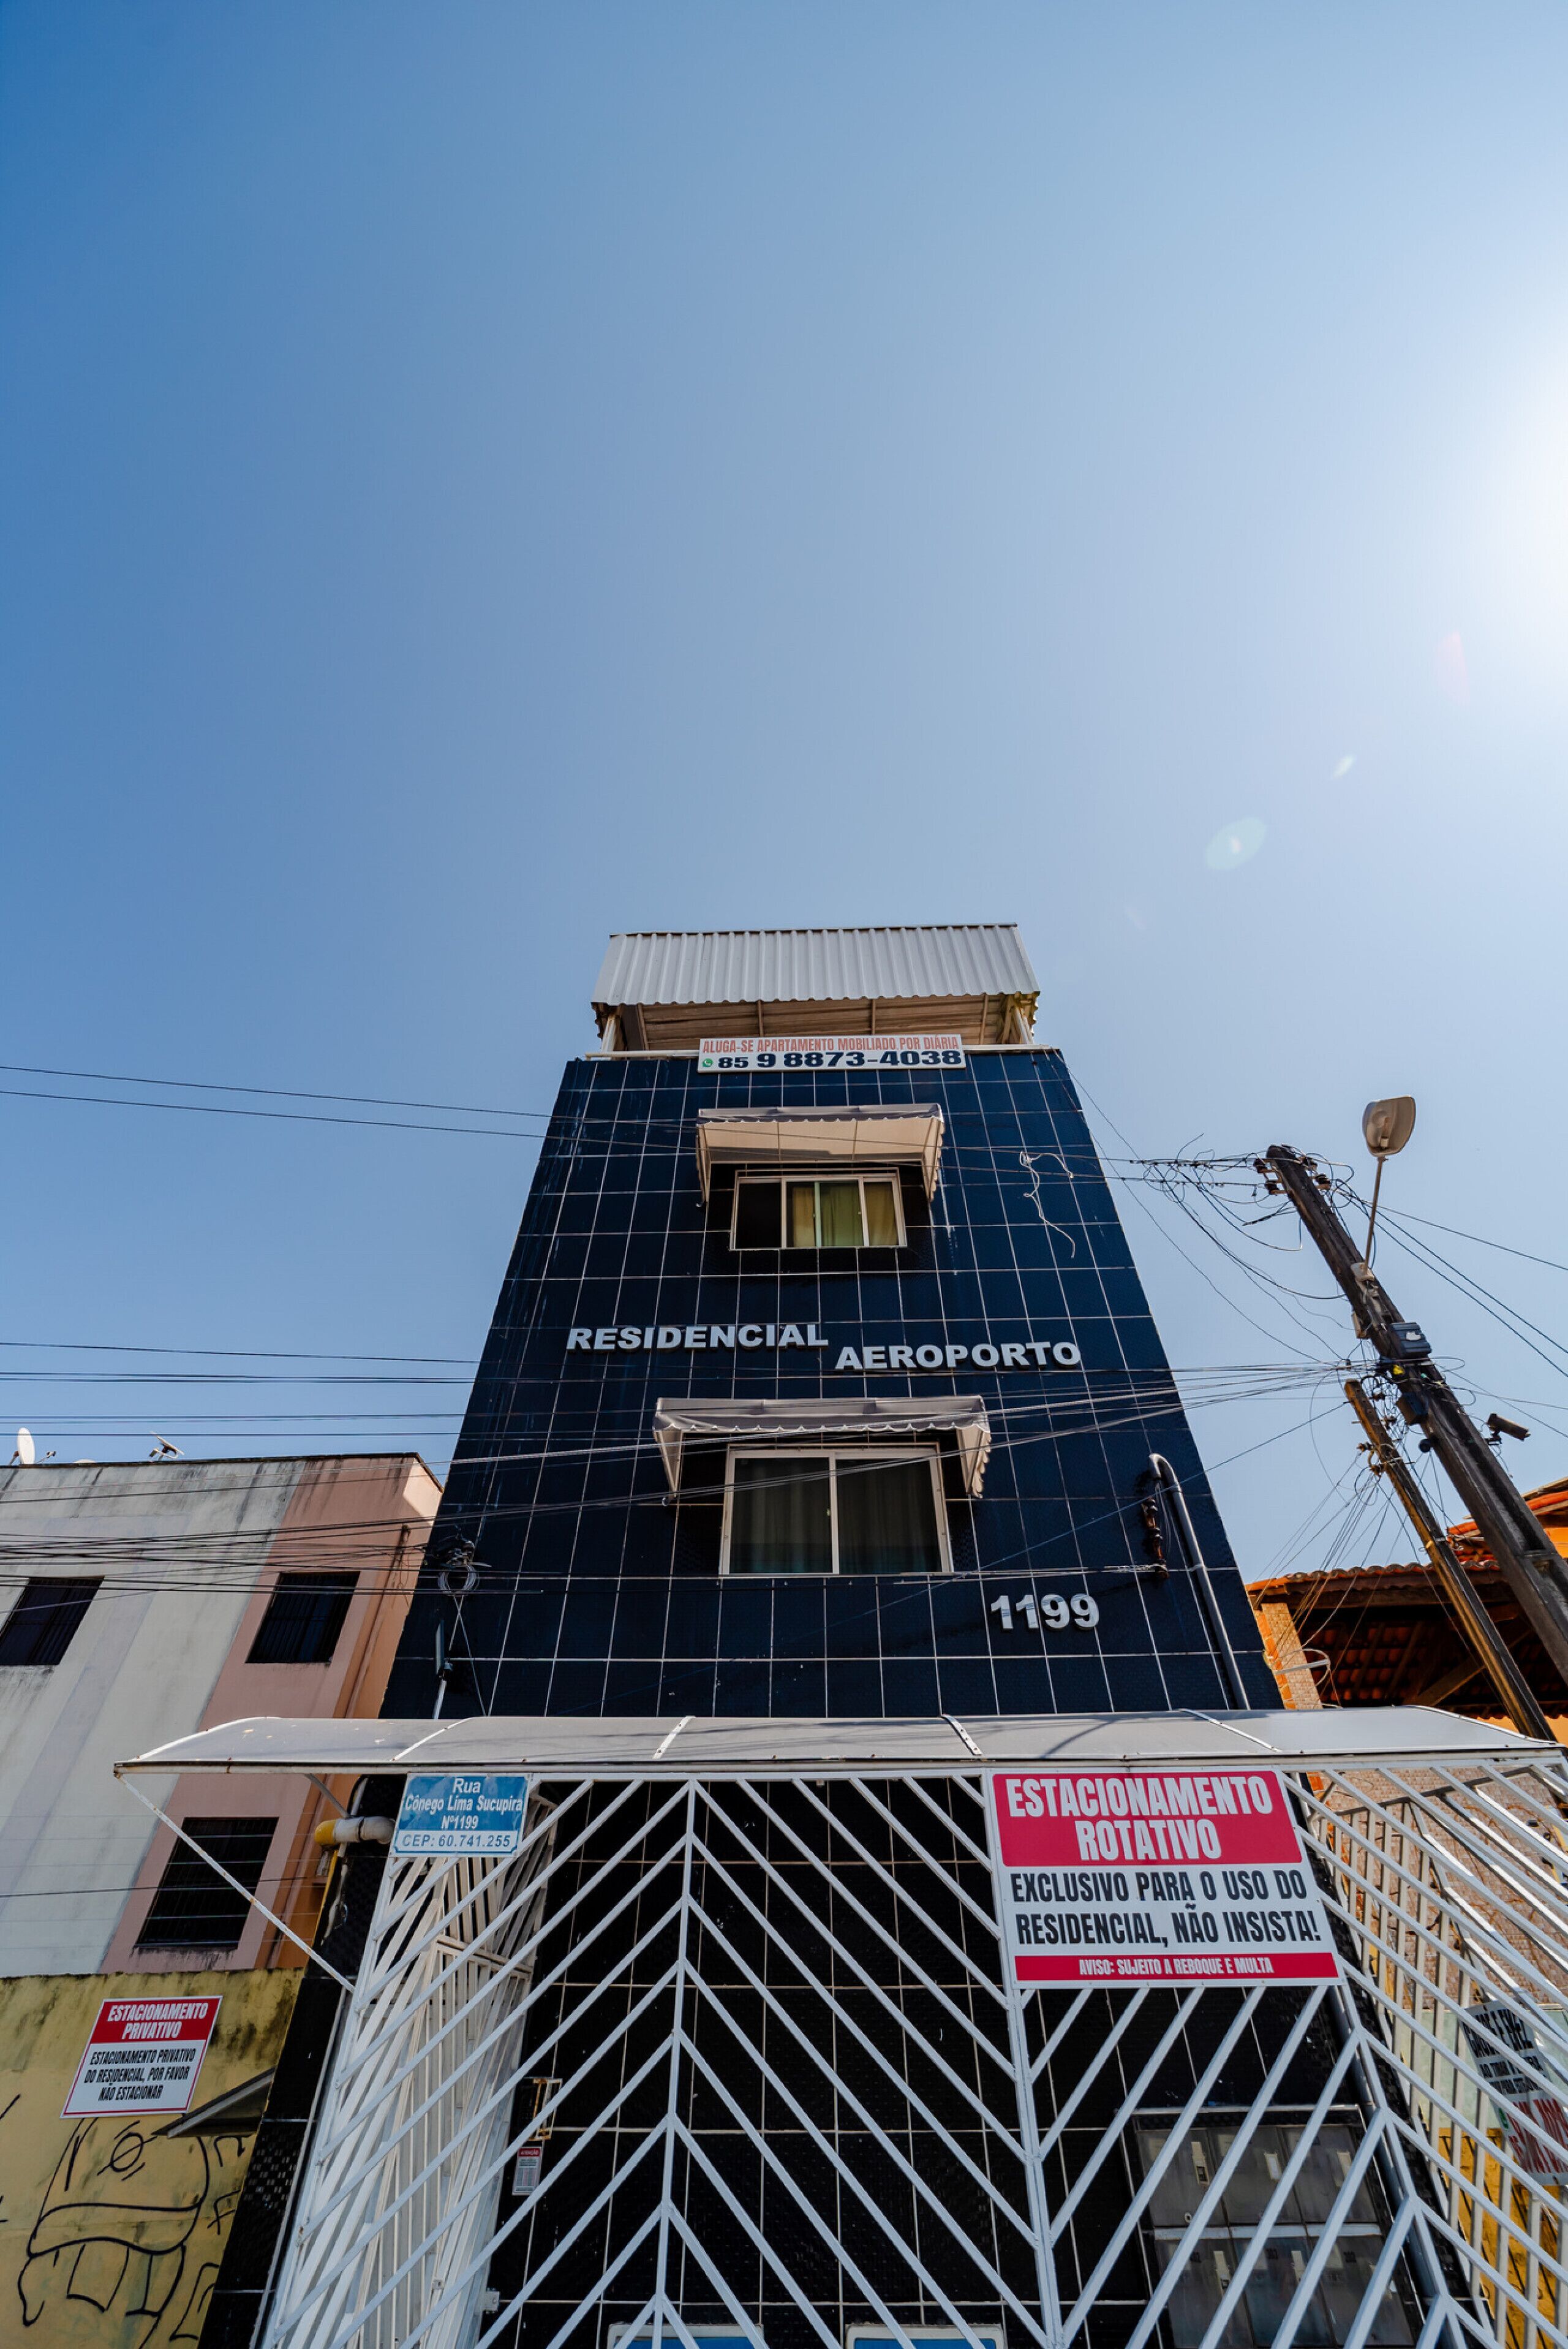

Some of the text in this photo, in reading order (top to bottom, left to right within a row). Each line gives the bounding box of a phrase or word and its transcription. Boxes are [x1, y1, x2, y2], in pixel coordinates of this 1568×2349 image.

[703, 1039, 753, 1053] ALUGA-SE
[757, 1038, 834, 1052] APARTAMENTO
[900, 1037, 921, 1050] POR
[924, 1035, 959, 1050] DIÁRIA
[718, 1051, 962, 1068] 85 9 8873-4038
[566, 1324, 829, 1352] RESIDENCIAL
[835, 1341, 1082, 1372] AEROPORTO
[990, 1594, 1099, 1630] 1199
[453, 1777, 481, 1794] Rua
[405, 1794, 522, 1815] Cônego Lima Sucupira
[1005, 1776, 1273, 1817] ESTACIONAMENTO
[402, 1834, 511, 1848] CEP: 60.741.255
[1075, 1818, 1222, 1861] ROTATIVO
[1011, 1869, 1306, 1902] EXCLUSIVO PARA O USO DO
[1016, 1903, 1322, 1948] RESIDENCIAL, NÃO INSISTA!
[1079, 1957, 1275, 1975] AVISO: SUJEITO A REBOQUE E MULTA
[107, 2002, 209, 2022] ESTACIONAMENTO
[121, 2021, 183, 2040] PRIVATIVO
[89, 2048, 197, 2065] ESTACIONAMENTO PRIVATIVO
[83, 2066, 190, 2084] DO RESIDENCIAL, POR FAVOR
[115, 2085, 164, 2100] ESTACIONAR
